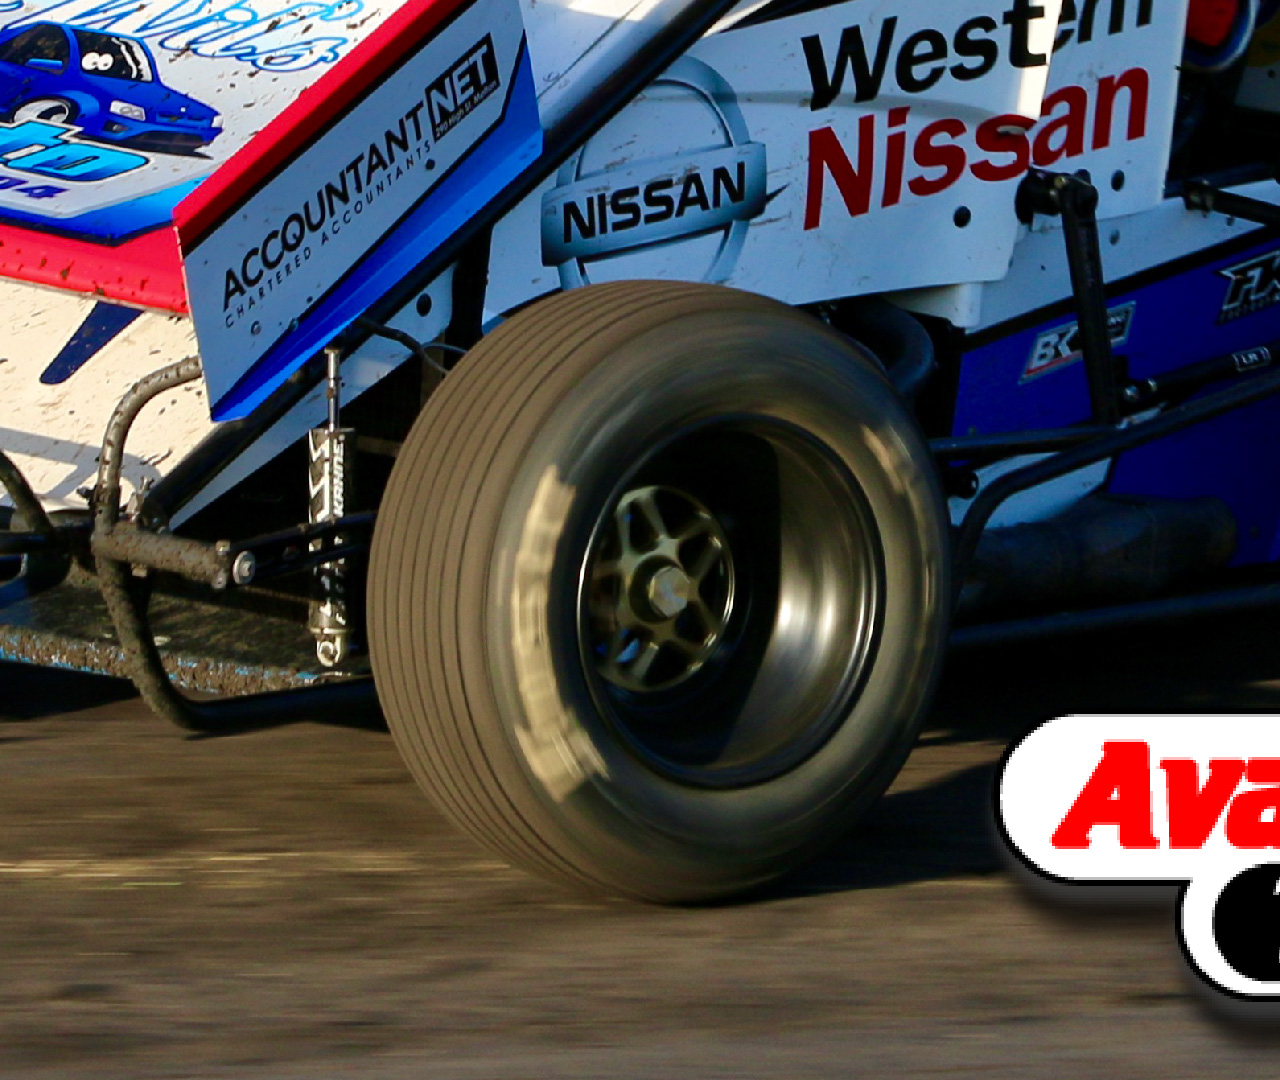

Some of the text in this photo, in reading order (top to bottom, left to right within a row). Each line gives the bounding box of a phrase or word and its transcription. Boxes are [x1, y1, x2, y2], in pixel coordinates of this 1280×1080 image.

[223, 44, 489, 312] ACCOUNTANT NET
[225, 141, 431, 328] CHARTERED ACCOUNTANTS
[563, 161, 746, 244] NISSAN
[802, 67, 1151, 231] Nissan
